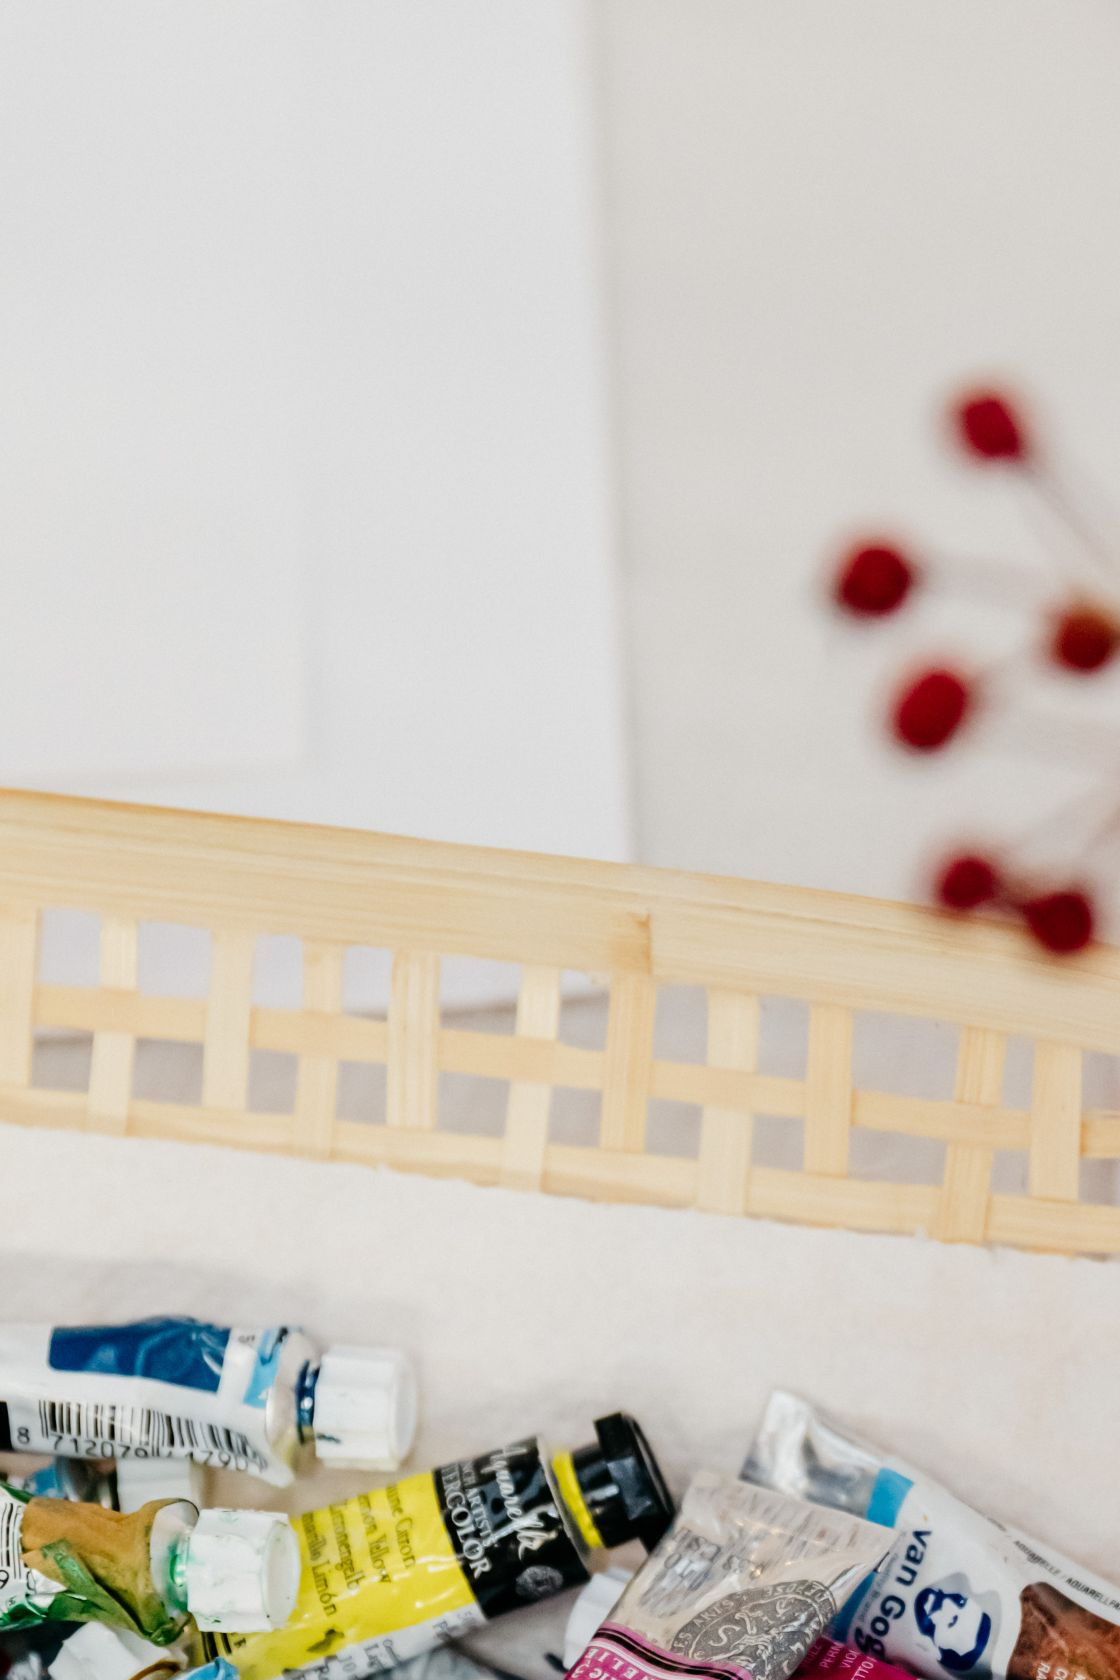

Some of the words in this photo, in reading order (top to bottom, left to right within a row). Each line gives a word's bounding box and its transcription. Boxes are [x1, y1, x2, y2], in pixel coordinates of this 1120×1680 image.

[17, 1425, 31, 1445] 8
[889, 1524, 939, 1589] van
[848, 1590, 906, 1661] Gog
